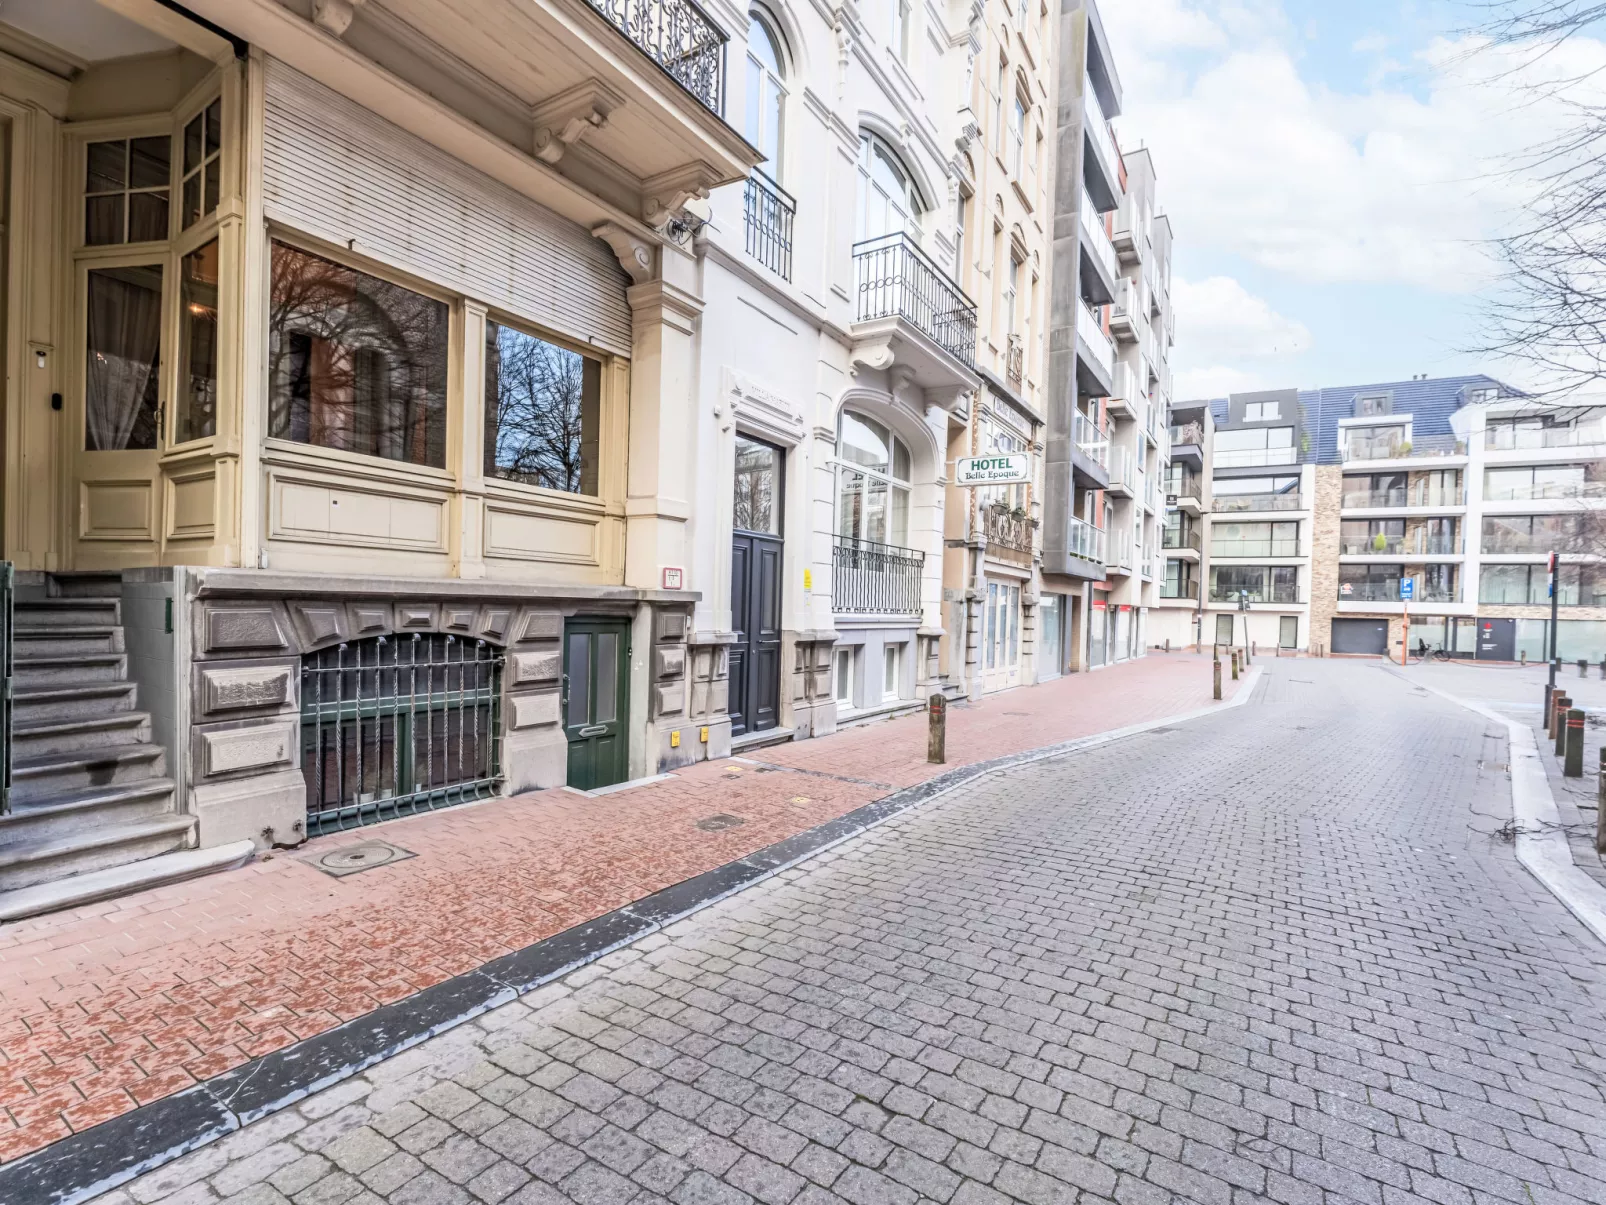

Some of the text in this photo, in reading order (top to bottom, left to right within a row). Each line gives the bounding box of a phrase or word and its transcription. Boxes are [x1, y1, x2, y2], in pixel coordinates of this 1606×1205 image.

[971, 458, 1012, 470] HOTEL
[965, 471, 1019, 480] Belle Epoque
[1403, 579, 1411, 587] P
